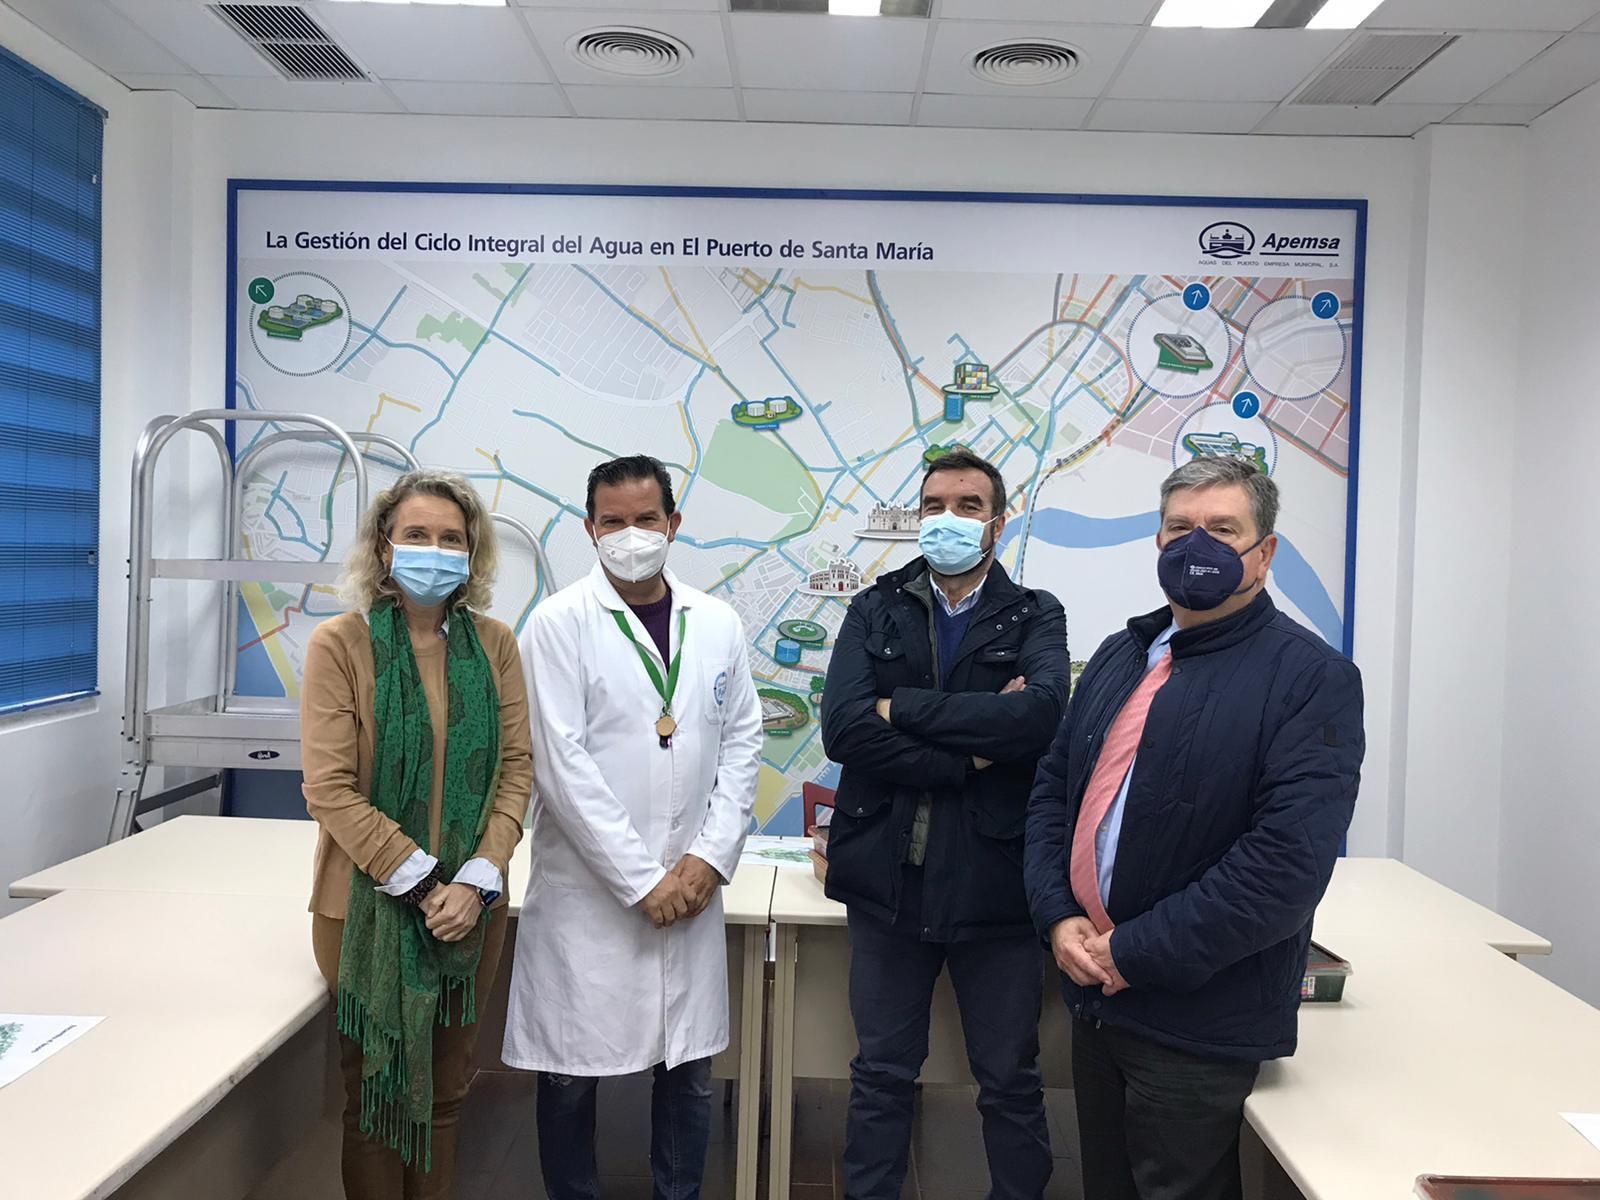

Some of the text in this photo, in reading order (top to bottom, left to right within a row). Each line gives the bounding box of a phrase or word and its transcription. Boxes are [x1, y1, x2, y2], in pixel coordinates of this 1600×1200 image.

[267, 231, 933, 260] La Gestión del Ciclo Integral del Agua en El Puerto de Santa María
[1261, 232, 1340, 252] Apemsa
